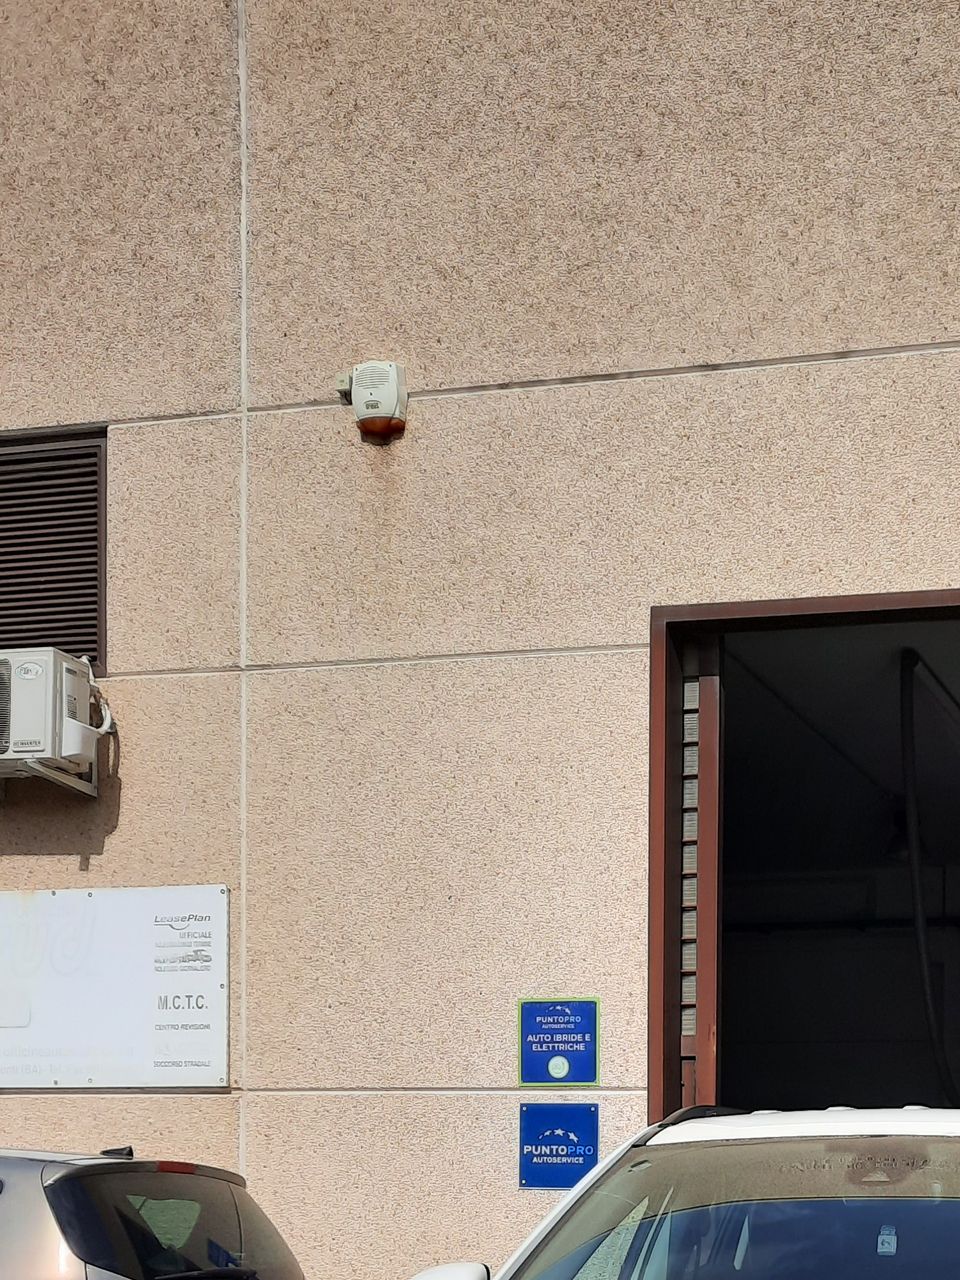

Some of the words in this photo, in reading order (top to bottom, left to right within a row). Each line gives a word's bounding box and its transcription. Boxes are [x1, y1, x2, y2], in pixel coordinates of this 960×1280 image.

[154, 914, 211, 923] LeasePlan
[157, 994, 208, 1010] M.C.T.C.
[527, 1034, 551, 1042] AUTO
[553, 1034, 583, 1042] IBRIDE
[585, 1033, 591, 1041] E
[532, 1043, 586, 1051] ELETTRICHE
[523, 1145, 594, 1155] PUNTOPRO
[532, 1156, 584, 1164] AUTOSERVICE
